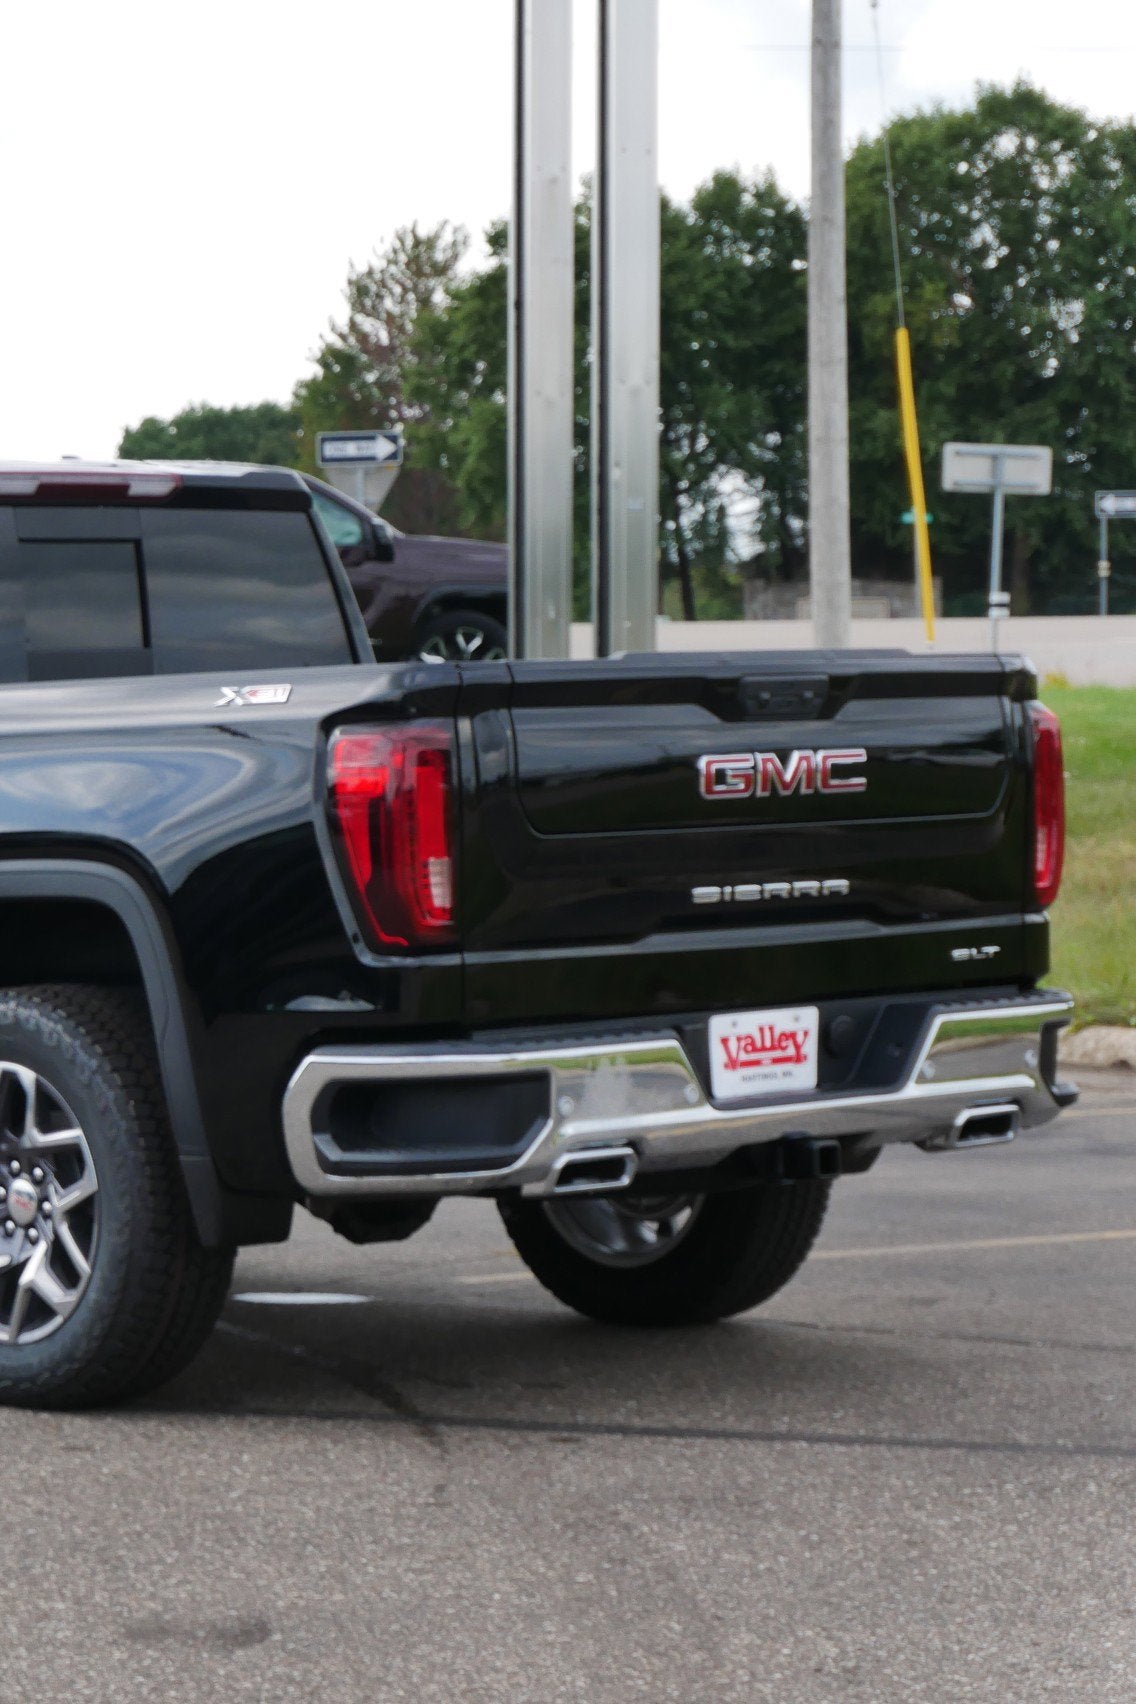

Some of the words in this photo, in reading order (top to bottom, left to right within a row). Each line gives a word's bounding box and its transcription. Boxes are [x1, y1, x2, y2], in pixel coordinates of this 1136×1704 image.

[697, 748, 868, 800] GMC
[691, 878, 850, 904] SIERRA
[720, 1024, 810, 1071] Valley
